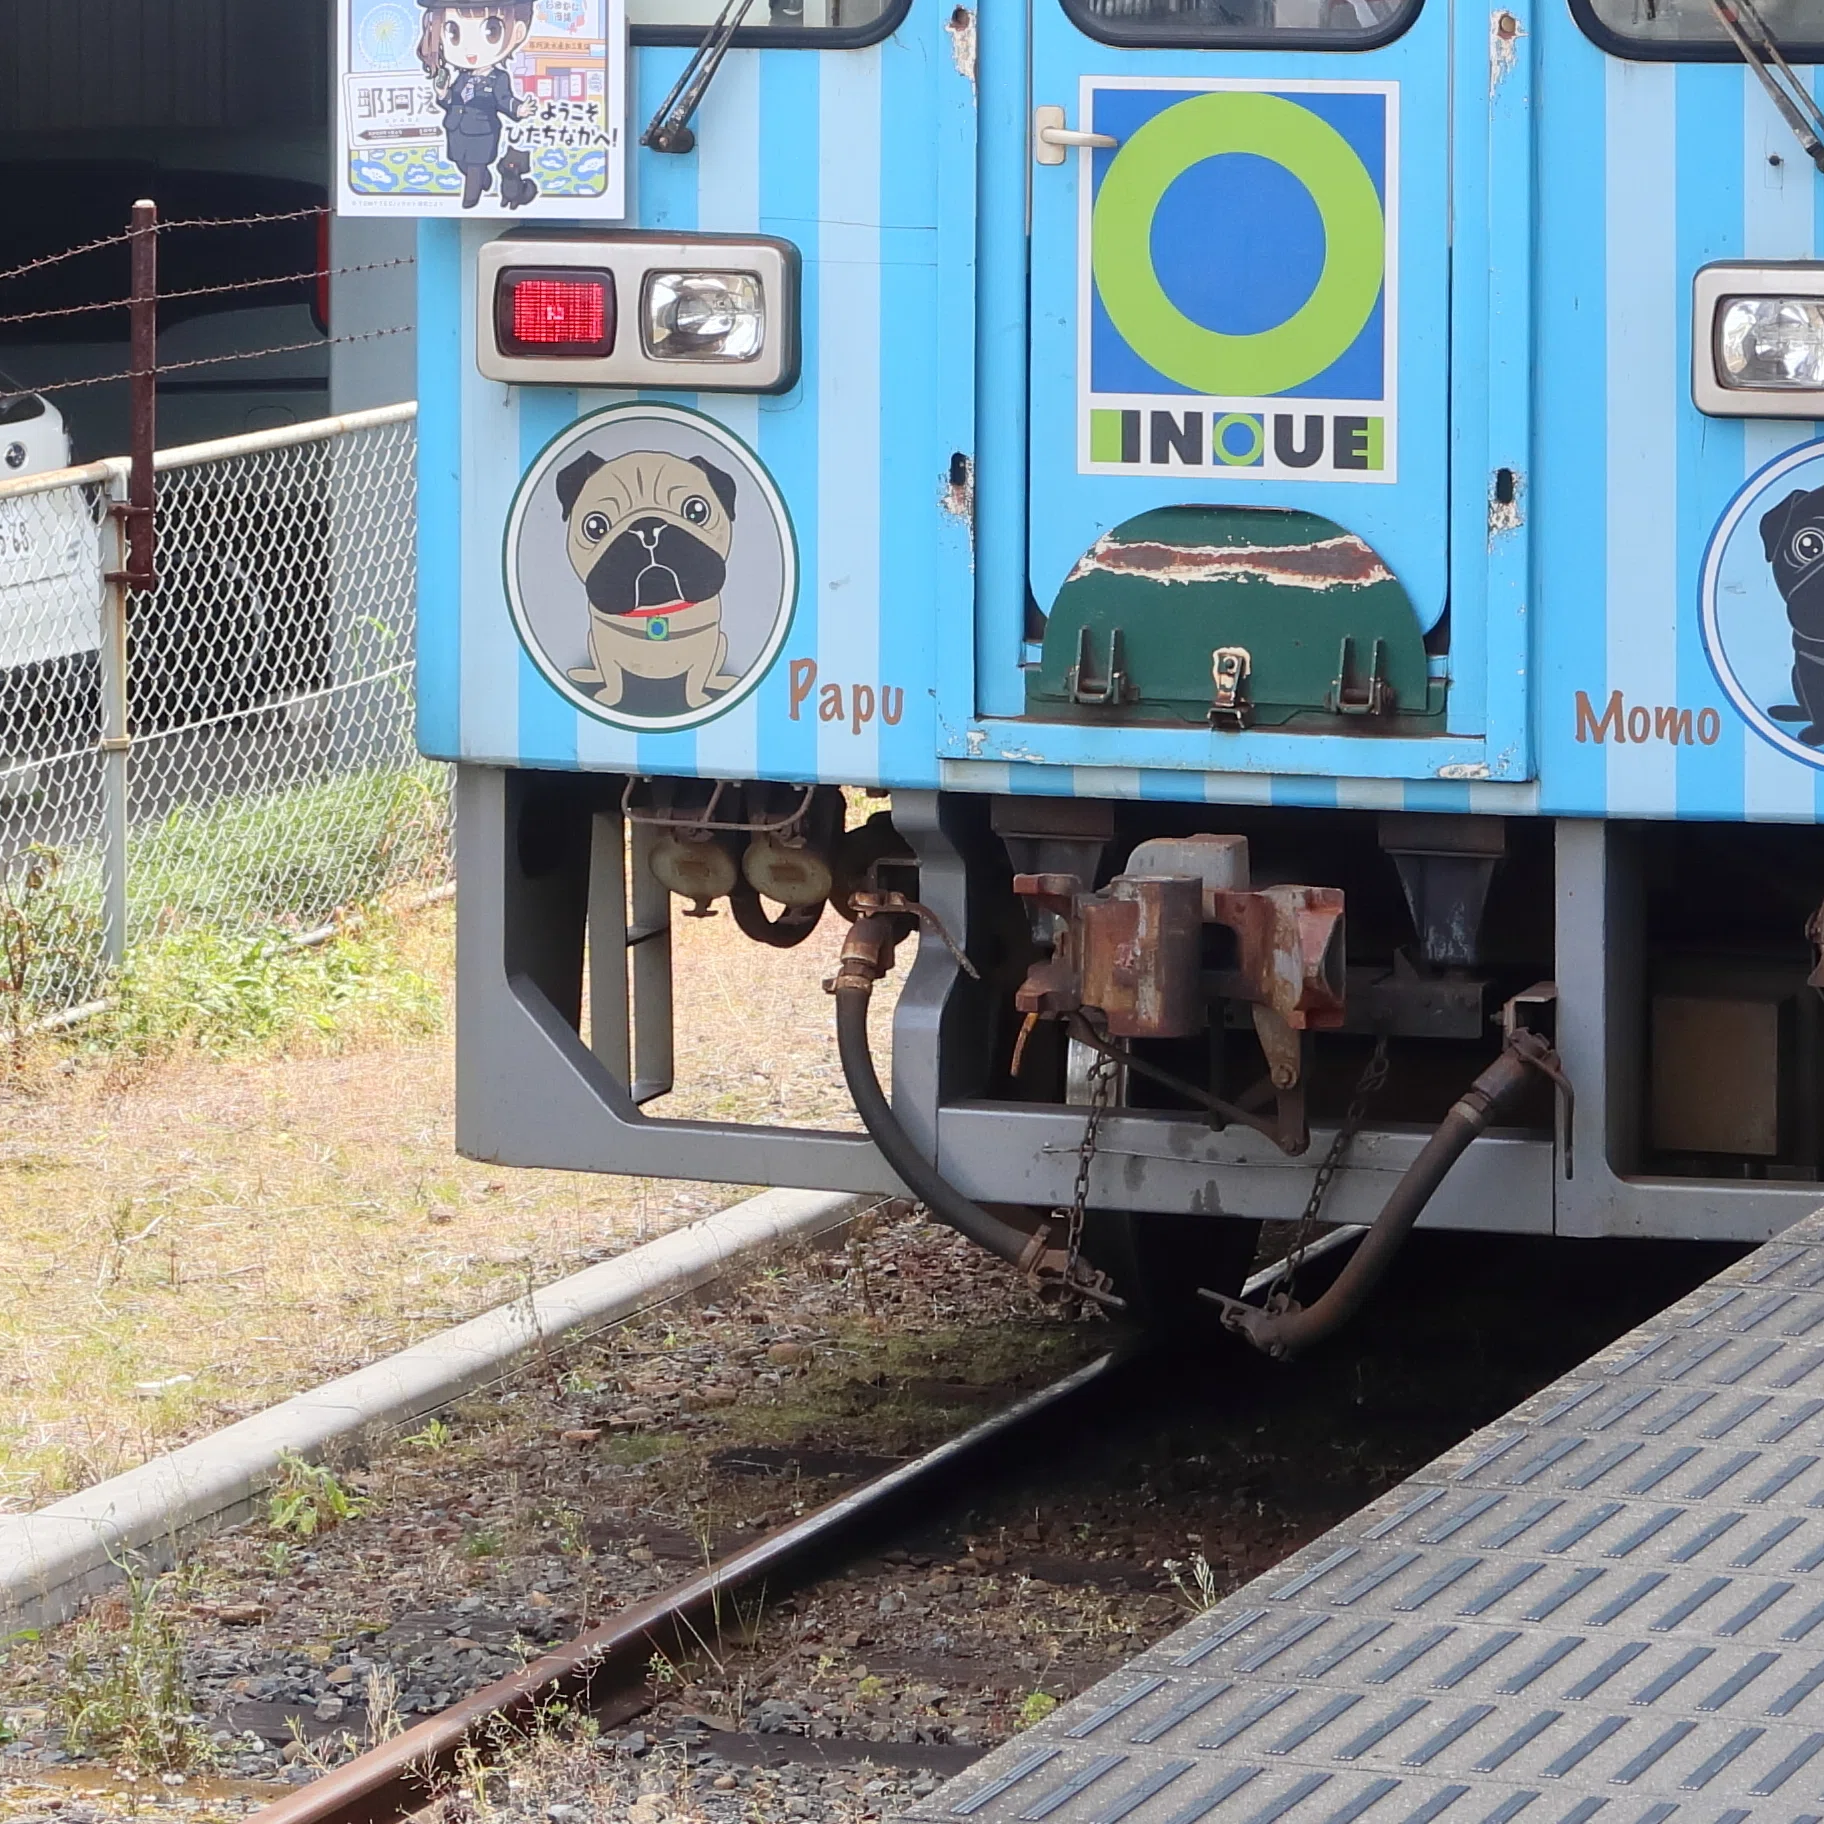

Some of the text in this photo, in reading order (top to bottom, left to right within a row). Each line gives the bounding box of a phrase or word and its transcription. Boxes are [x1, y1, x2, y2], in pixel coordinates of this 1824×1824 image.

[539, 101, 601, 123] ようこそ
[1090, 408, 1385, 472] INOUE
[788, 657, 904, 736] Papu
[1575, 690, 1721, 747] Momo
